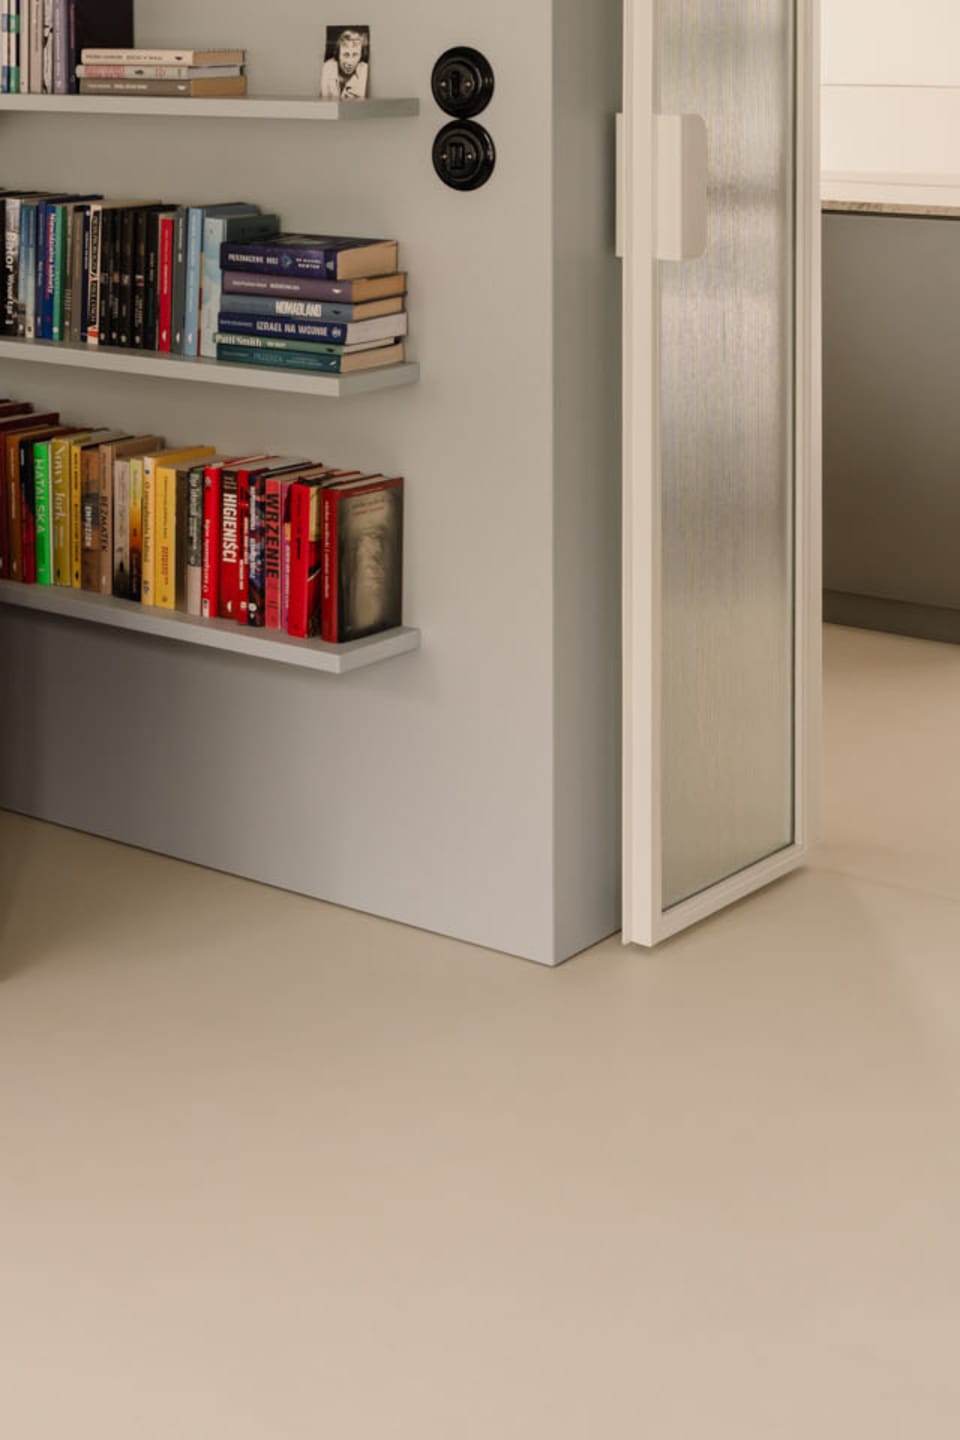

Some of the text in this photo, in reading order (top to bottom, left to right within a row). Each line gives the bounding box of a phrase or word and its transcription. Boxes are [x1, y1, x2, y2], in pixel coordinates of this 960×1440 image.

[255, 321, 282, 333] IZRAEL
[284, 323, 296, 333] NA
[275, 301, 322, 317] NOMADLAND
[237, 335, 262, 347] Smith
[54, 445, 66, 484] Nowy
[34, 458, 46, 534] HATALSKA
[54, 490, 66, 521] Jork
[100, 496, 109, 552] BEZMATEK
[223, 493, 238, 563] HIGIENIŚCI
[265, 493, 280, 580] WRZENIE
